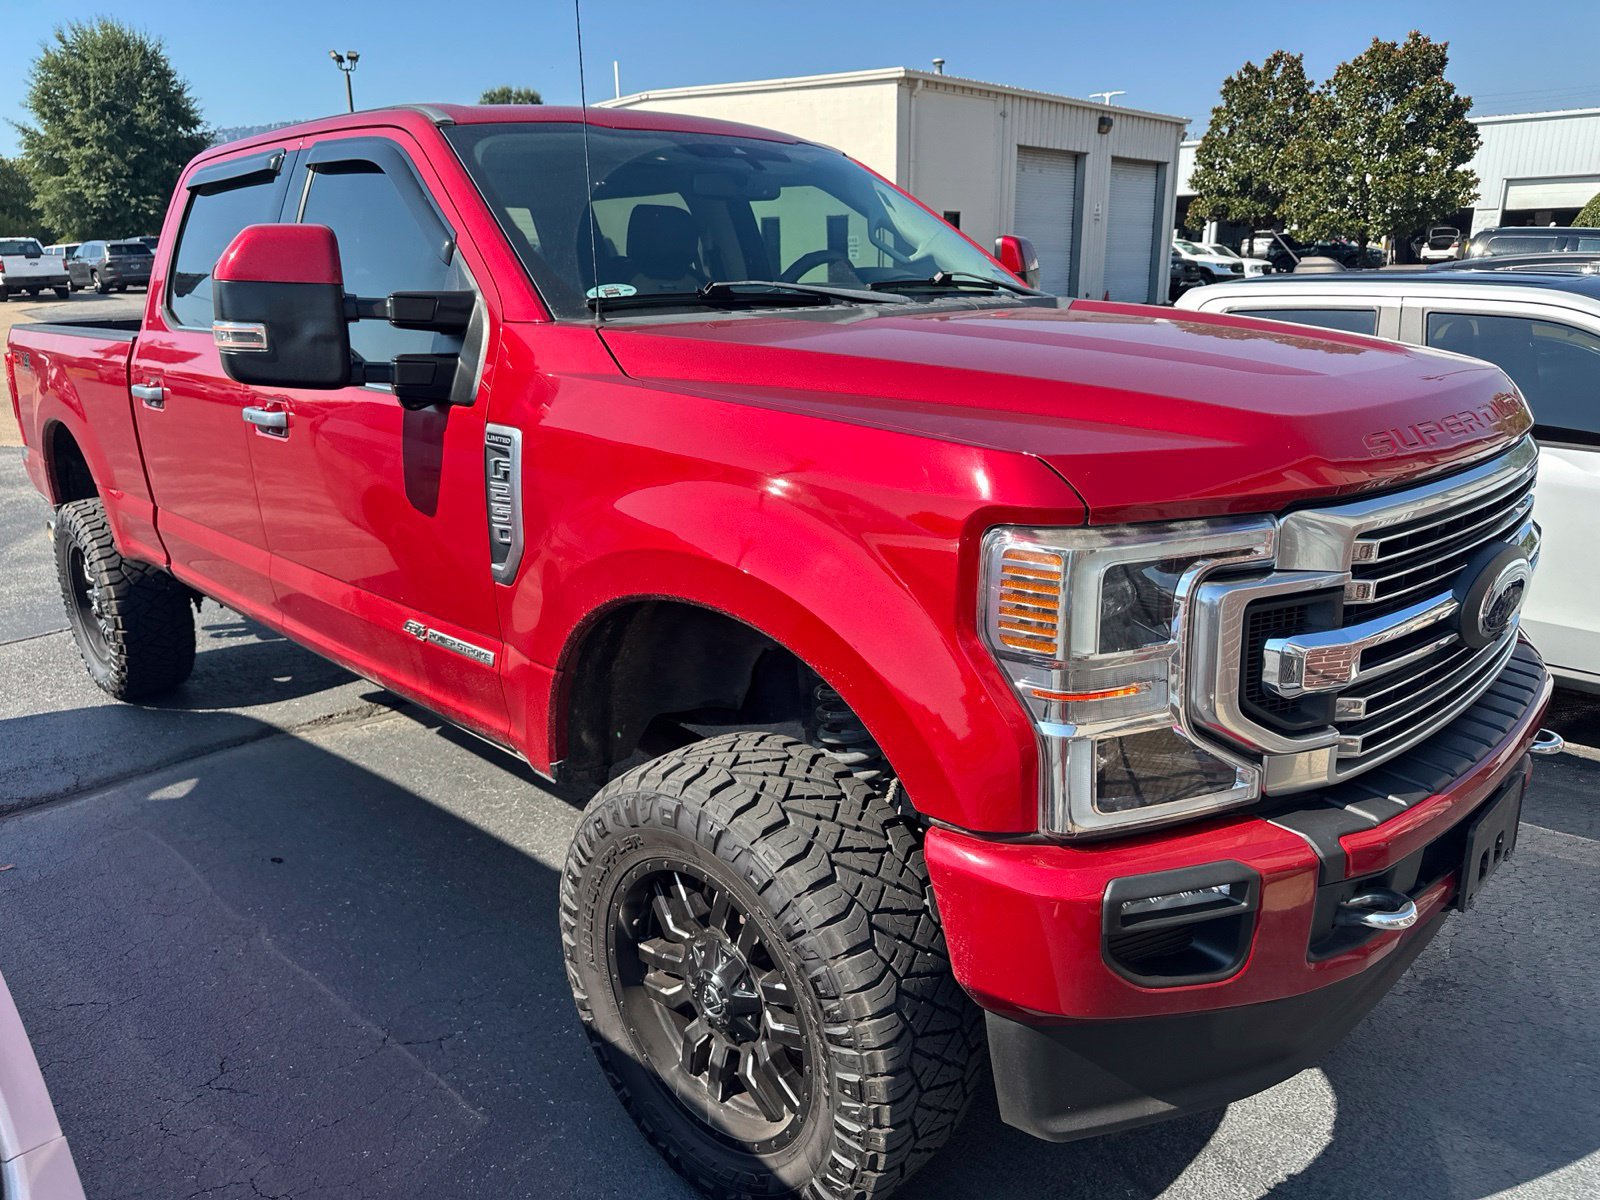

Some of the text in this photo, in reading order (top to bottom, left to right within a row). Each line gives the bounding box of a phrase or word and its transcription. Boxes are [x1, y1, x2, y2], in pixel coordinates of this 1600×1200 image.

[487, 434, 511, 444] LIMITED
[1362, 410, 1484, 458] SUPER
[428, 631, 456, 648] POWER
[457, 642, 492, 661] STROKE
